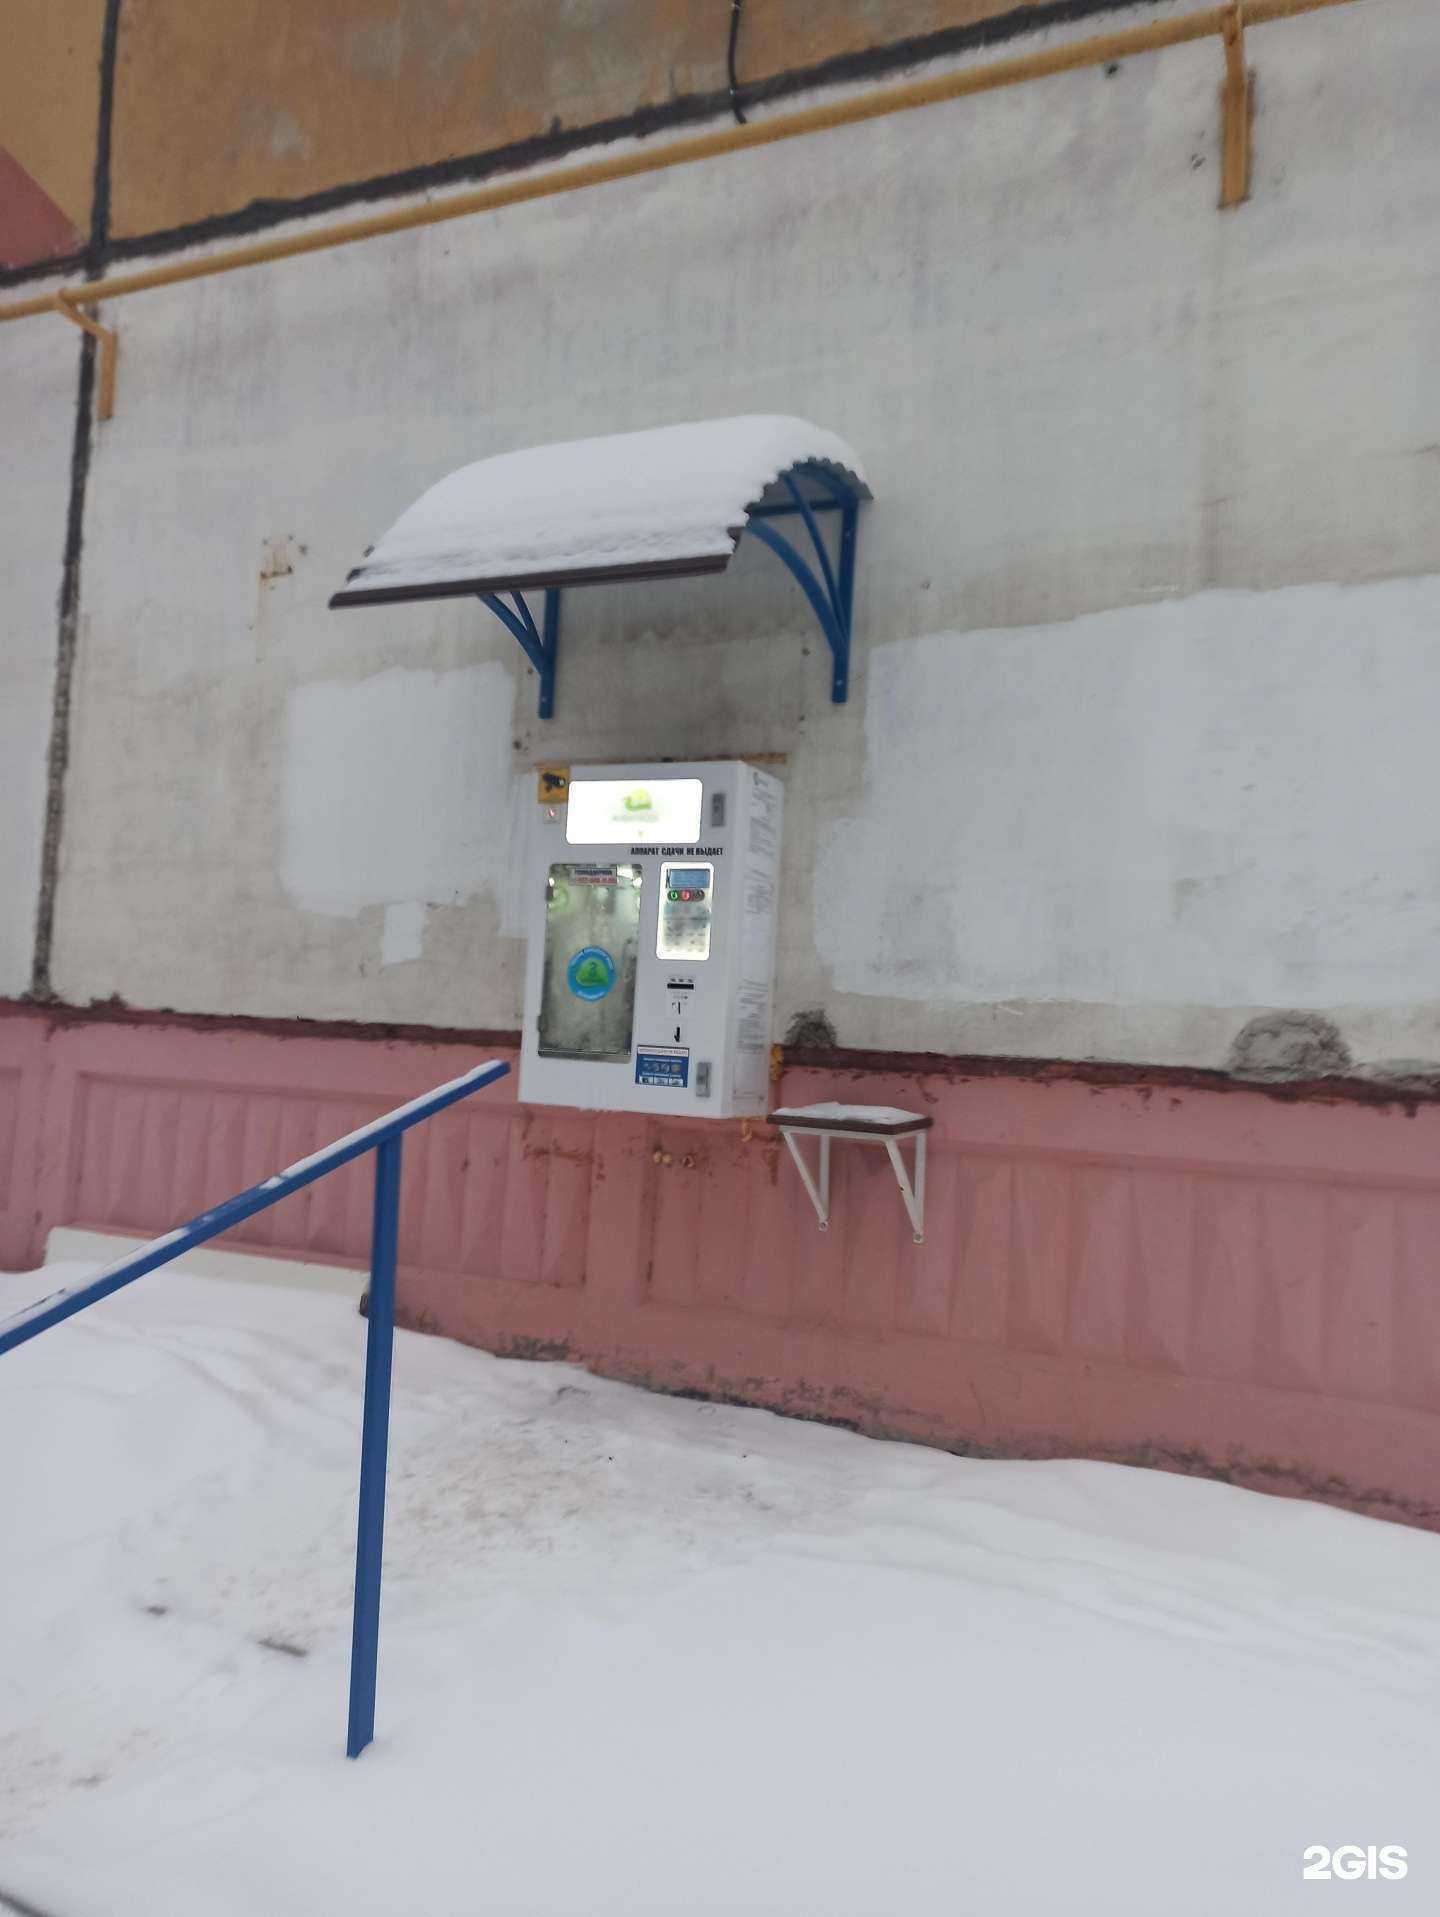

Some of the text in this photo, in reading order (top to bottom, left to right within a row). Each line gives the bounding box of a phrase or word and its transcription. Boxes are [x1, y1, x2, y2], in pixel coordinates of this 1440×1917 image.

[631, 847, 723, 857] АППАРАТ СДАЧИ НЕ ВЫДАЕТ
